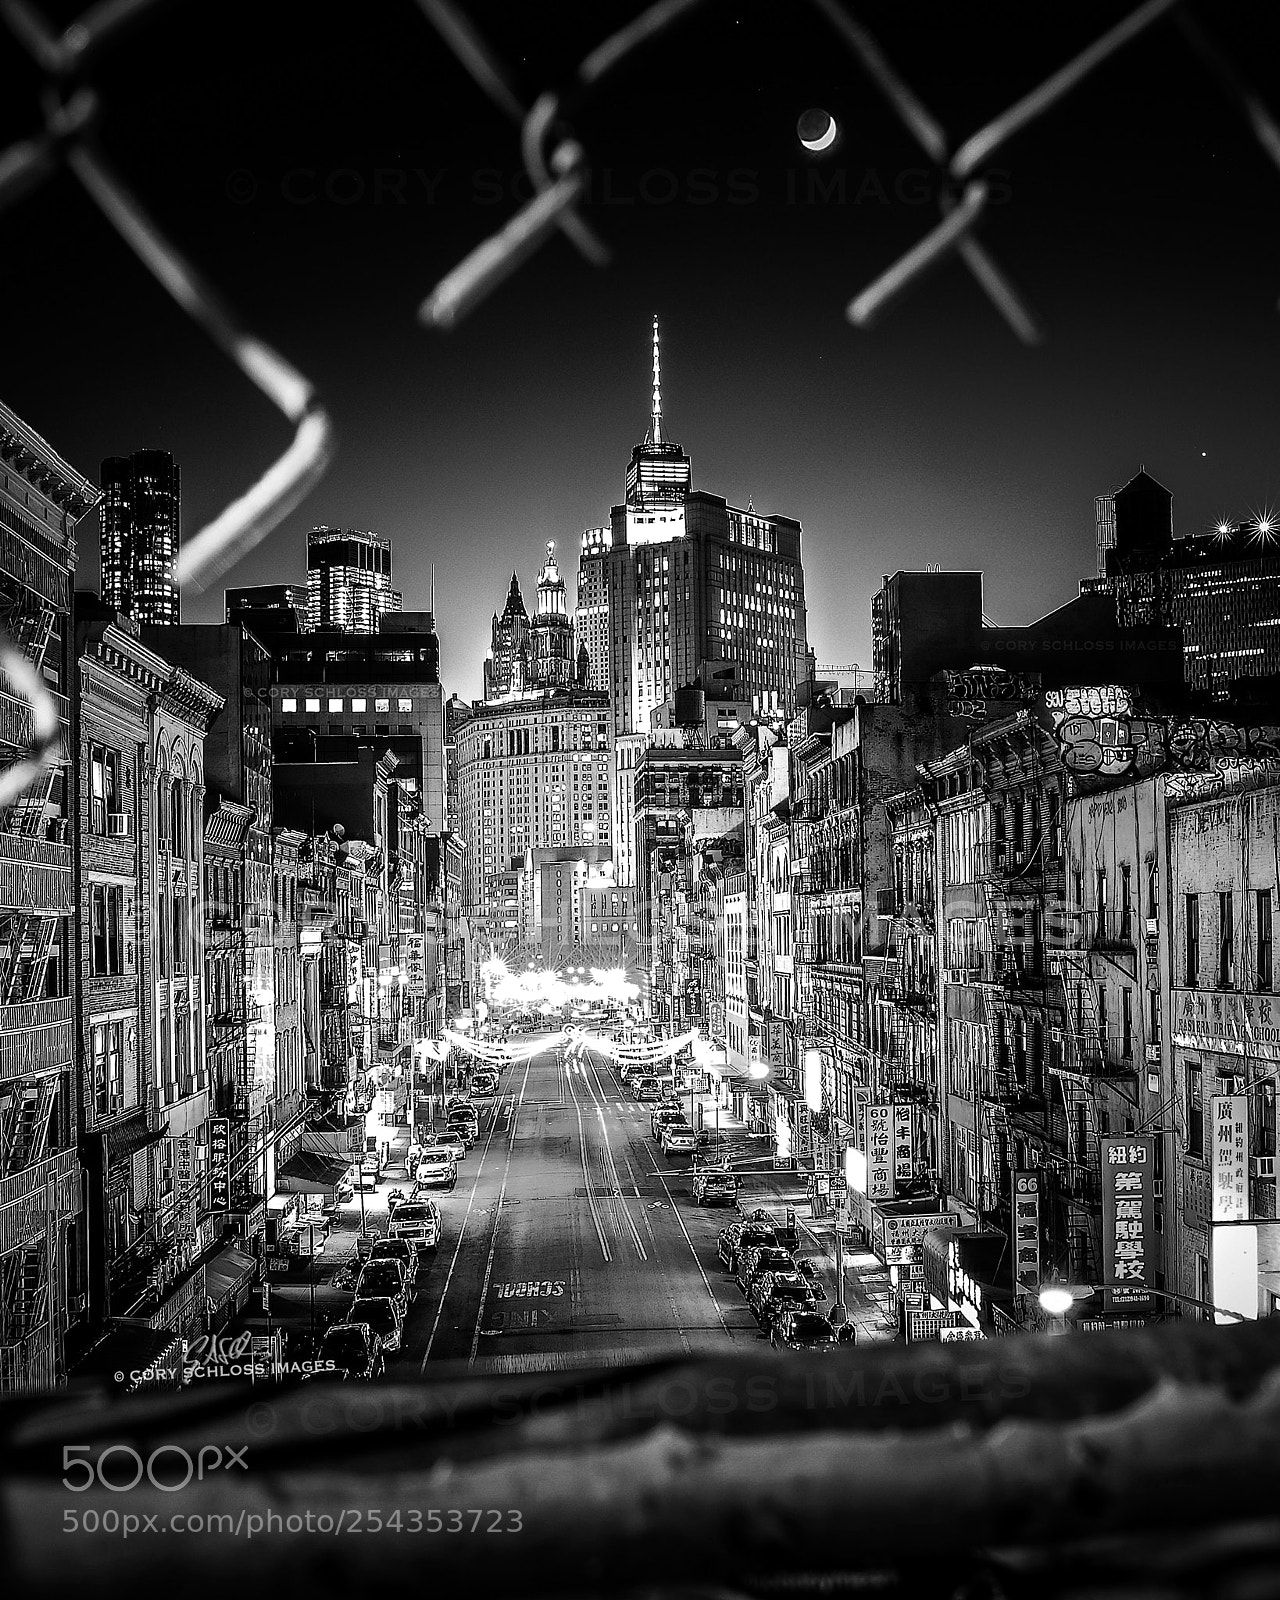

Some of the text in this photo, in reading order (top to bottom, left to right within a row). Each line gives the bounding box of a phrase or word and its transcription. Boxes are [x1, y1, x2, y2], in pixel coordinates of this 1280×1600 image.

[1214, 1022, 1245, 1039] DRIVNG
[1108, 1145, 1147, 1165] 紐約
[1017, 1178, 1038, 1192] 66
[1114, 1172, 1145, 1280] 第一駕駛學校
[493, 1281, 565, 1298] SCHOOL
